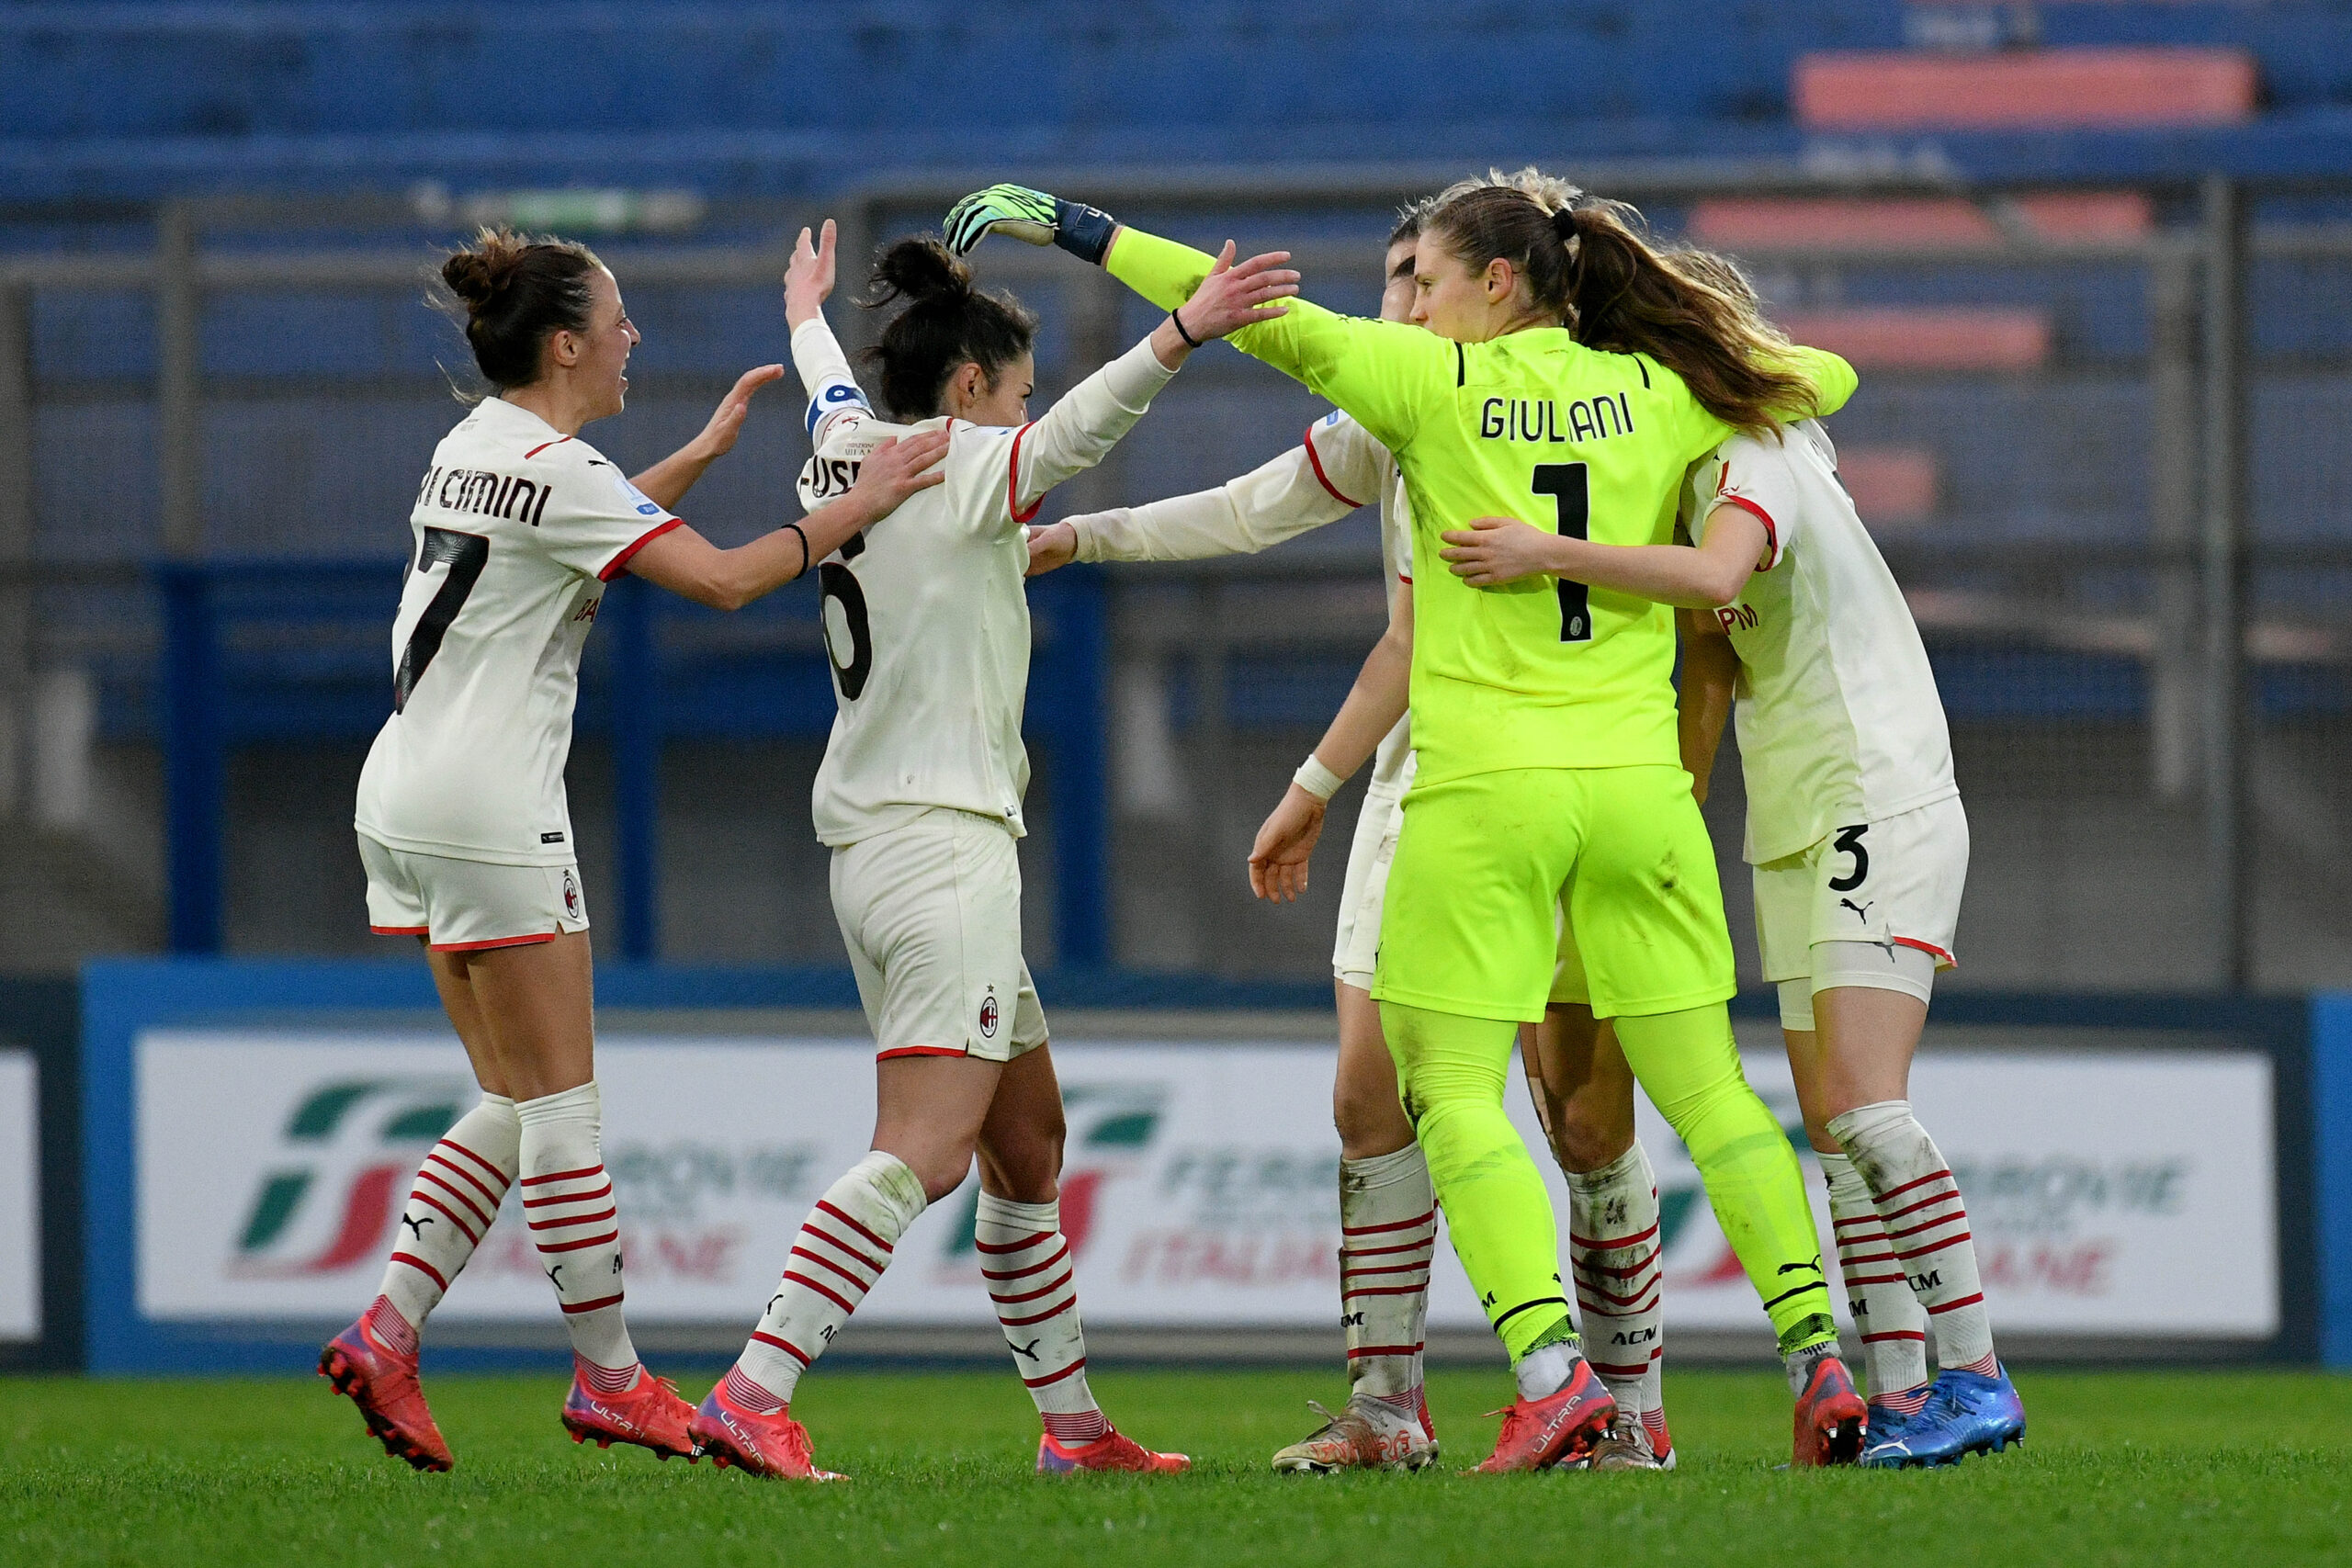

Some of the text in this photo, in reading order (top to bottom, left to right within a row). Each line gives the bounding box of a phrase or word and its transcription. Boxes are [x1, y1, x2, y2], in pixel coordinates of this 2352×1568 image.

[1480, 391, 1634, 444] GIULANI
[439, 469, 552, 527] CIMINI
[1532, 462, 1592, 643] 1
[394, 525, 491, 716] 7
[1717, 604, 1758, 636] PM
[1828, 824, 1869, 891] 3
[1907, 1269, 1943, 1292] CM
[1532, 1395, 1581, 1453] ULTRA
